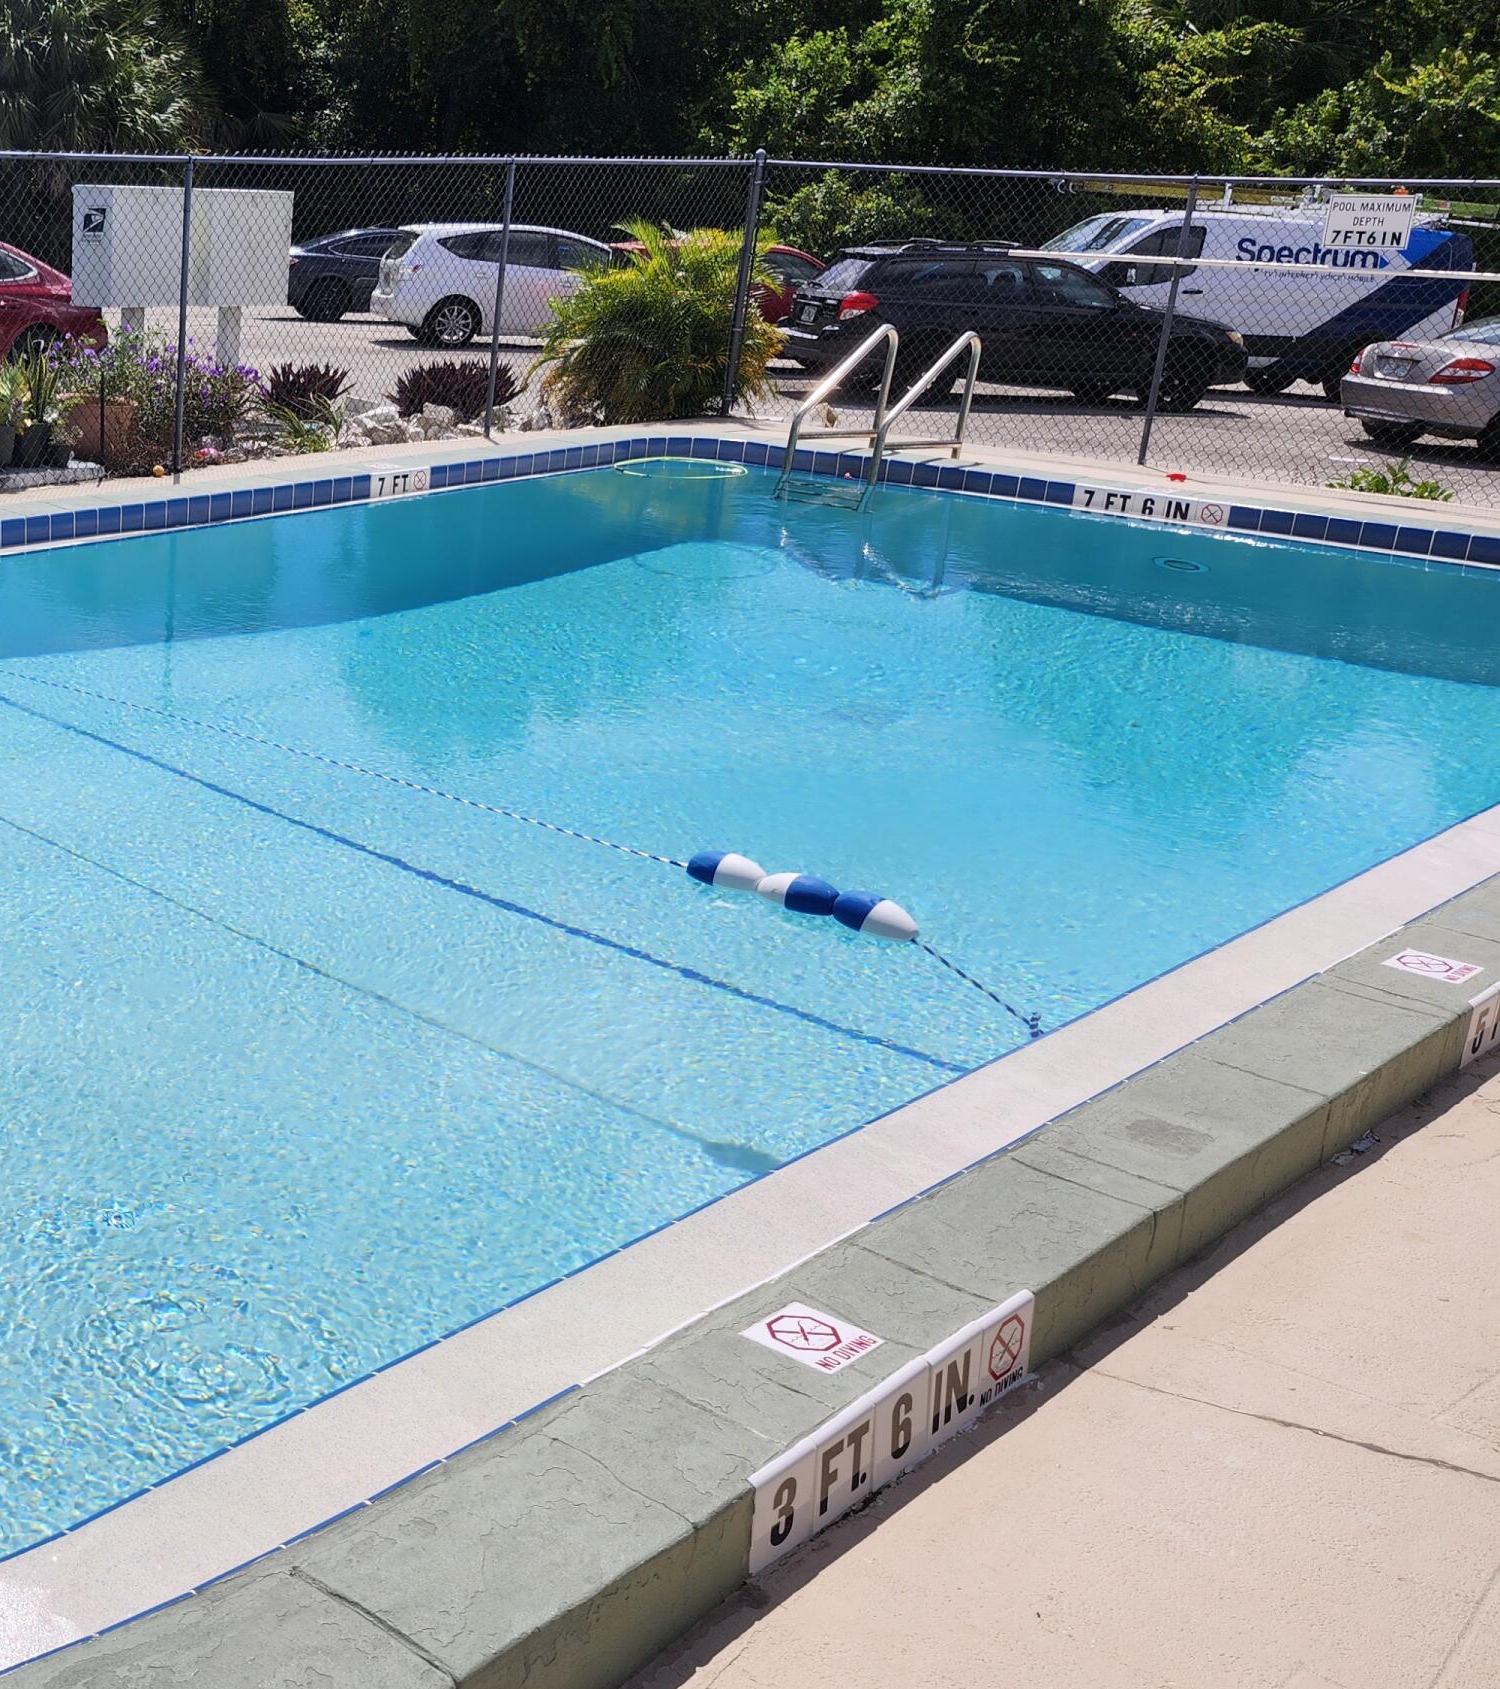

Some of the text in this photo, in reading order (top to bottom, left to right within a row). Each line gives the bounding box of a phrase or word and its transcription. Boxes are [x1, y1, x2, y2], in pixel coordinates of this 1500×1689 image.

[1333, 202, 1411, 213] POOL MAXIMUM
[1353, 217, 1384, 226] DEPTH
[1236, 238, 1378, 271] Spectrum
[378, 477, 386, 497] 7
[1084, 490, 1096, 507] 7
[1141, 498, 1155, 515] 6
[1471, 1007, 1490, 1055] 5
[814, 1335, 877, 1371] NO DIVING
[979, 1366, 1023, 1408] NO DIVING
[770, 1347, 975, 1546] 3 FT. 6 IN.
